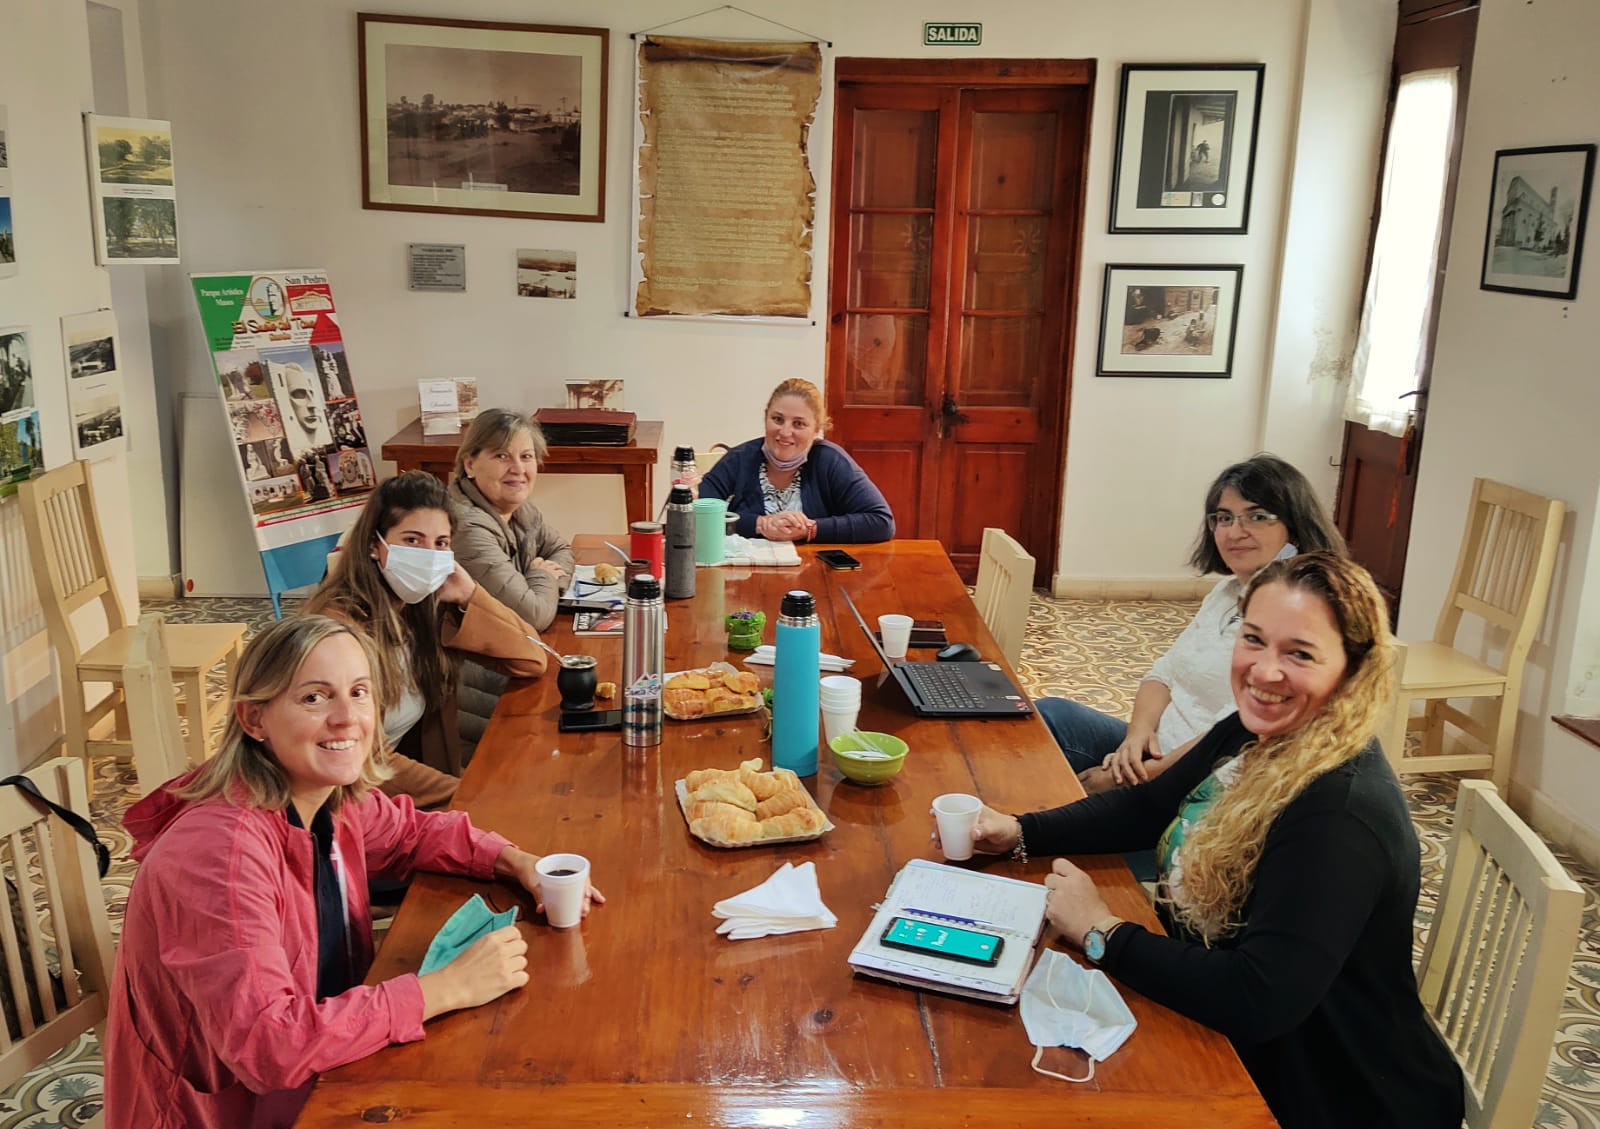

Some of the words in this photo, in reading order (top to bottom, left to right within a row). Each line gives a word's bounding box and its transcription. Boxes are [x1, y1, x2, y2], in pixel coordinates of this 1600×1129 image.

[928, 27, 977, 41] SALIDA
[285, 275, 301, 285] San
[303, 274, 327, 284] Pedro
